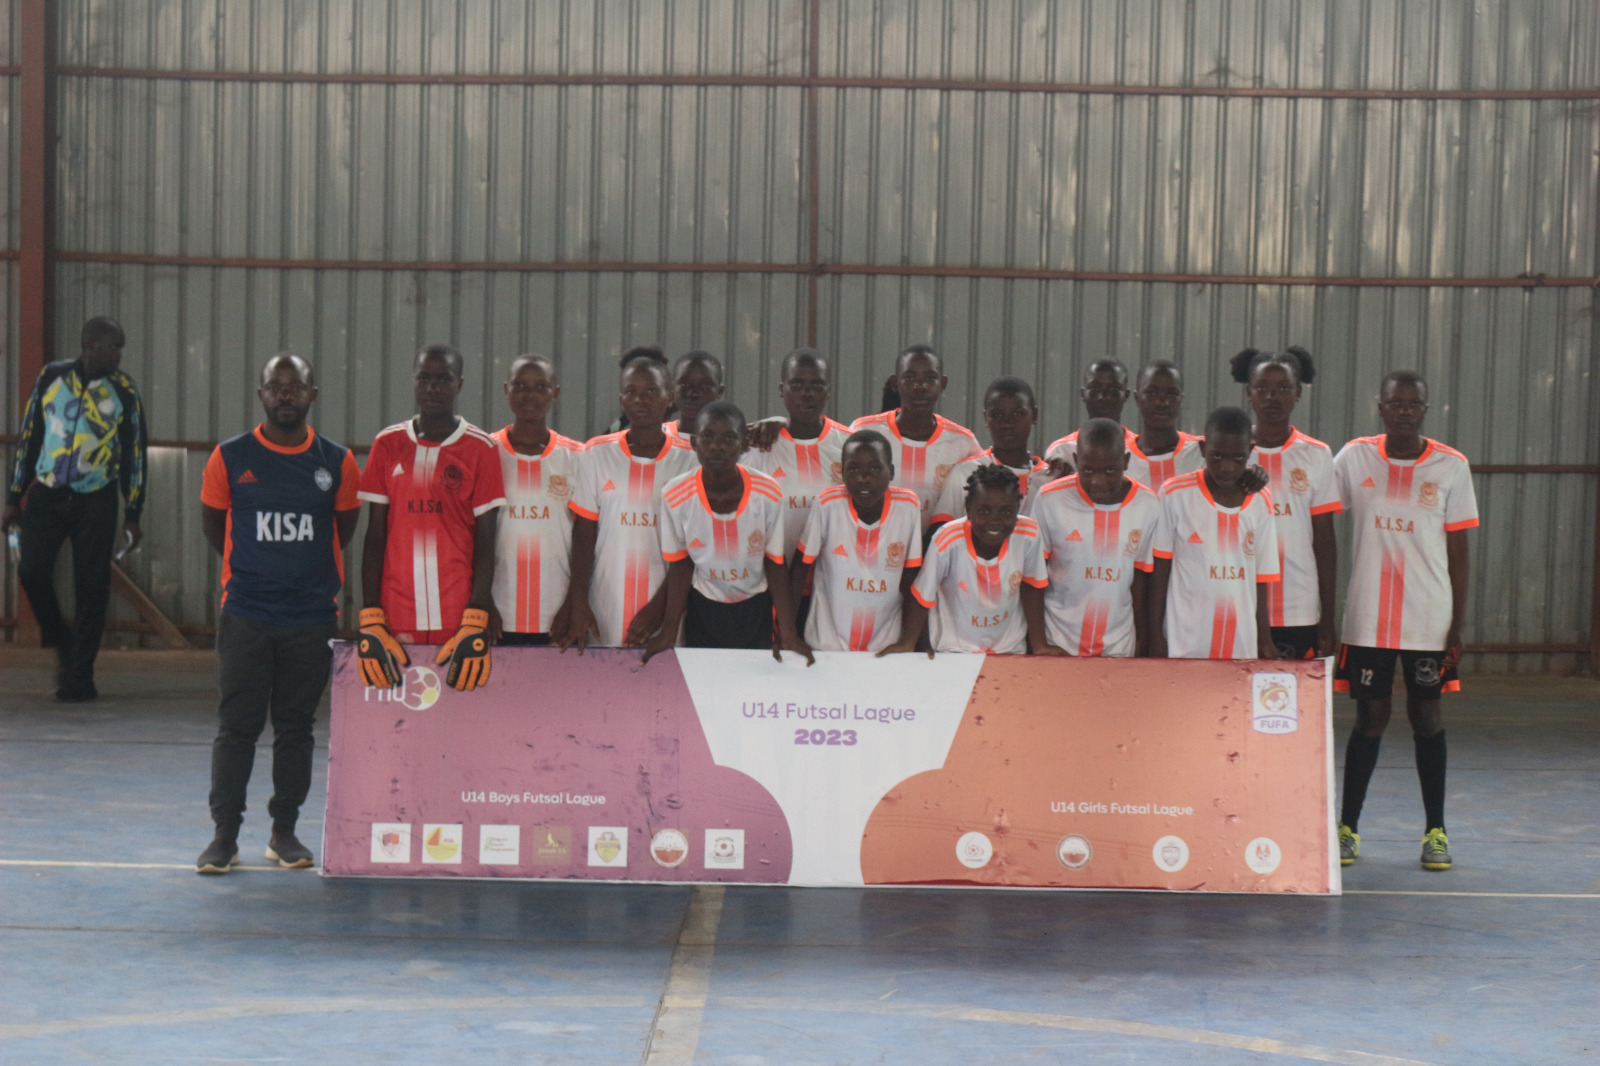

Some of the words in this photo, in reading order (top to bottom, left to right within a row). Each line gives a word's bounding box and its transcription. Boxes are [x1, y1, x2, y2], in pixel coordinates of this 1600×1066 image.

[408, 498, 443, 514] K.I.S.A
[509, 505, 550, 519] K.I.S.A
[256, 511, 314, 542] KISA
[1375, 515, 1415, 533] K.I.S.A
[709, 567, 749, 581] K.I.S.A
[1209, 566, 1245, 580] K.I.S.A
[846, 577, 887, 593] K.I.S.A
[1360, 668, 1374, 686] 12
[741, 702, 779, 719] U14
[785, 702, 847, 721] Futsal
[853, 704, 916, 724] Lague
[1260, 719, 1289, 730] FUFA
[794, 728, 858, 746] 2023
[461, 790, 486, 803] U14
[488, 790, 520, 806] Boys
[523, 791, 563, 804] Futsal
[566, 792, 606, 806] Lague
[1051, 801, 1075, 813] U14
[1078, 801, 1108, 814] Girls
[1110, 802, 1151, 815] Futsal
[1153, 803, 1194, 817] Lague
